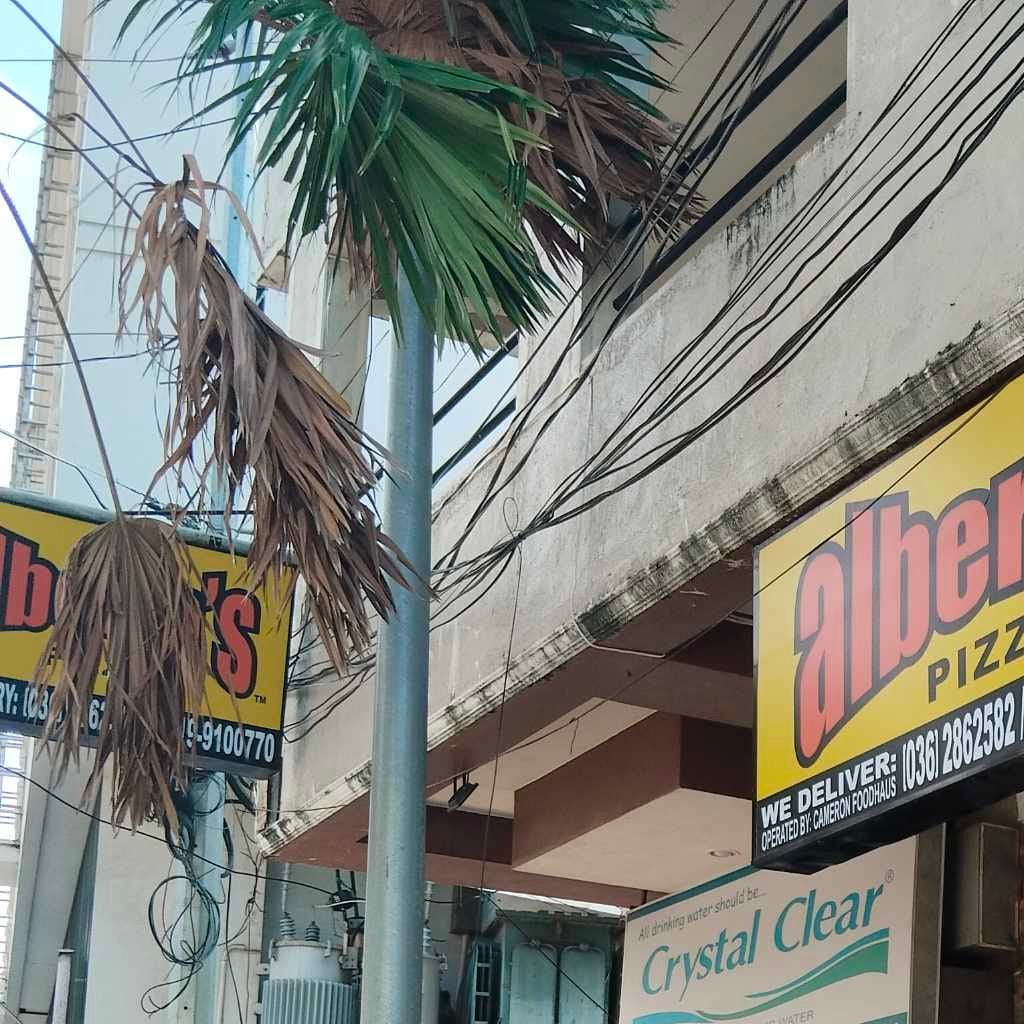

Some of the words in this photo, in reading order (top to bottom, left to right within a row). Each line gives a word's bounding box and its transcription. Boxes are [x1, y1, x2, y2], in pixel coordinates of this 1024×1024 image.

[761, 799, 792, 828] WE
[798, 751, 898, 814] DELIVER:
[902, 737, 940, 791] (036)
[942, 697, 1016, 773] 2862582
[761, 820, 799, 850] OPERATED
[799, 814, 813, 837] BY:
[813, 799, 851, 830] CAMERON
[852, 775, 897, 816] FOODHAUS
[638, 926, 650, 941] All
[651, 913, 686, 936] drinking
[687, 905, 714, 924] water
[714, 889, 745, 913] should
[641, 909, 762, 1002] Crystal
[774, 883, 885, 953] Clear
